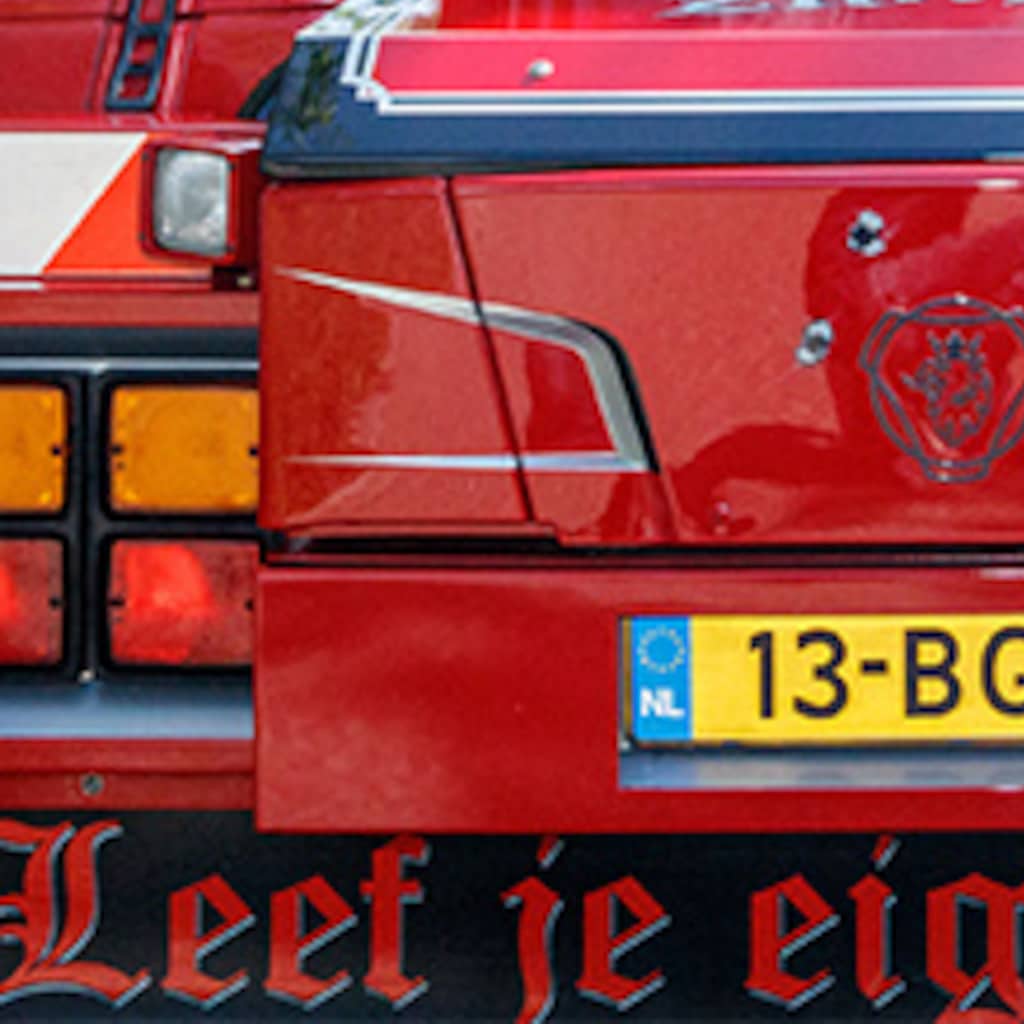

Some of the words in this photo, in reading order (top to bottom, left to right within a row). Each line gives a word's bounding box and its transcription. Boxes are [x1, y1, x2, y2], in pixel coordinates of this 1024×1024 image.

[639, 689, 685, 717] NL
[0, 821, 430, 1009] Leef
[502, 838, 670, 1024] je
